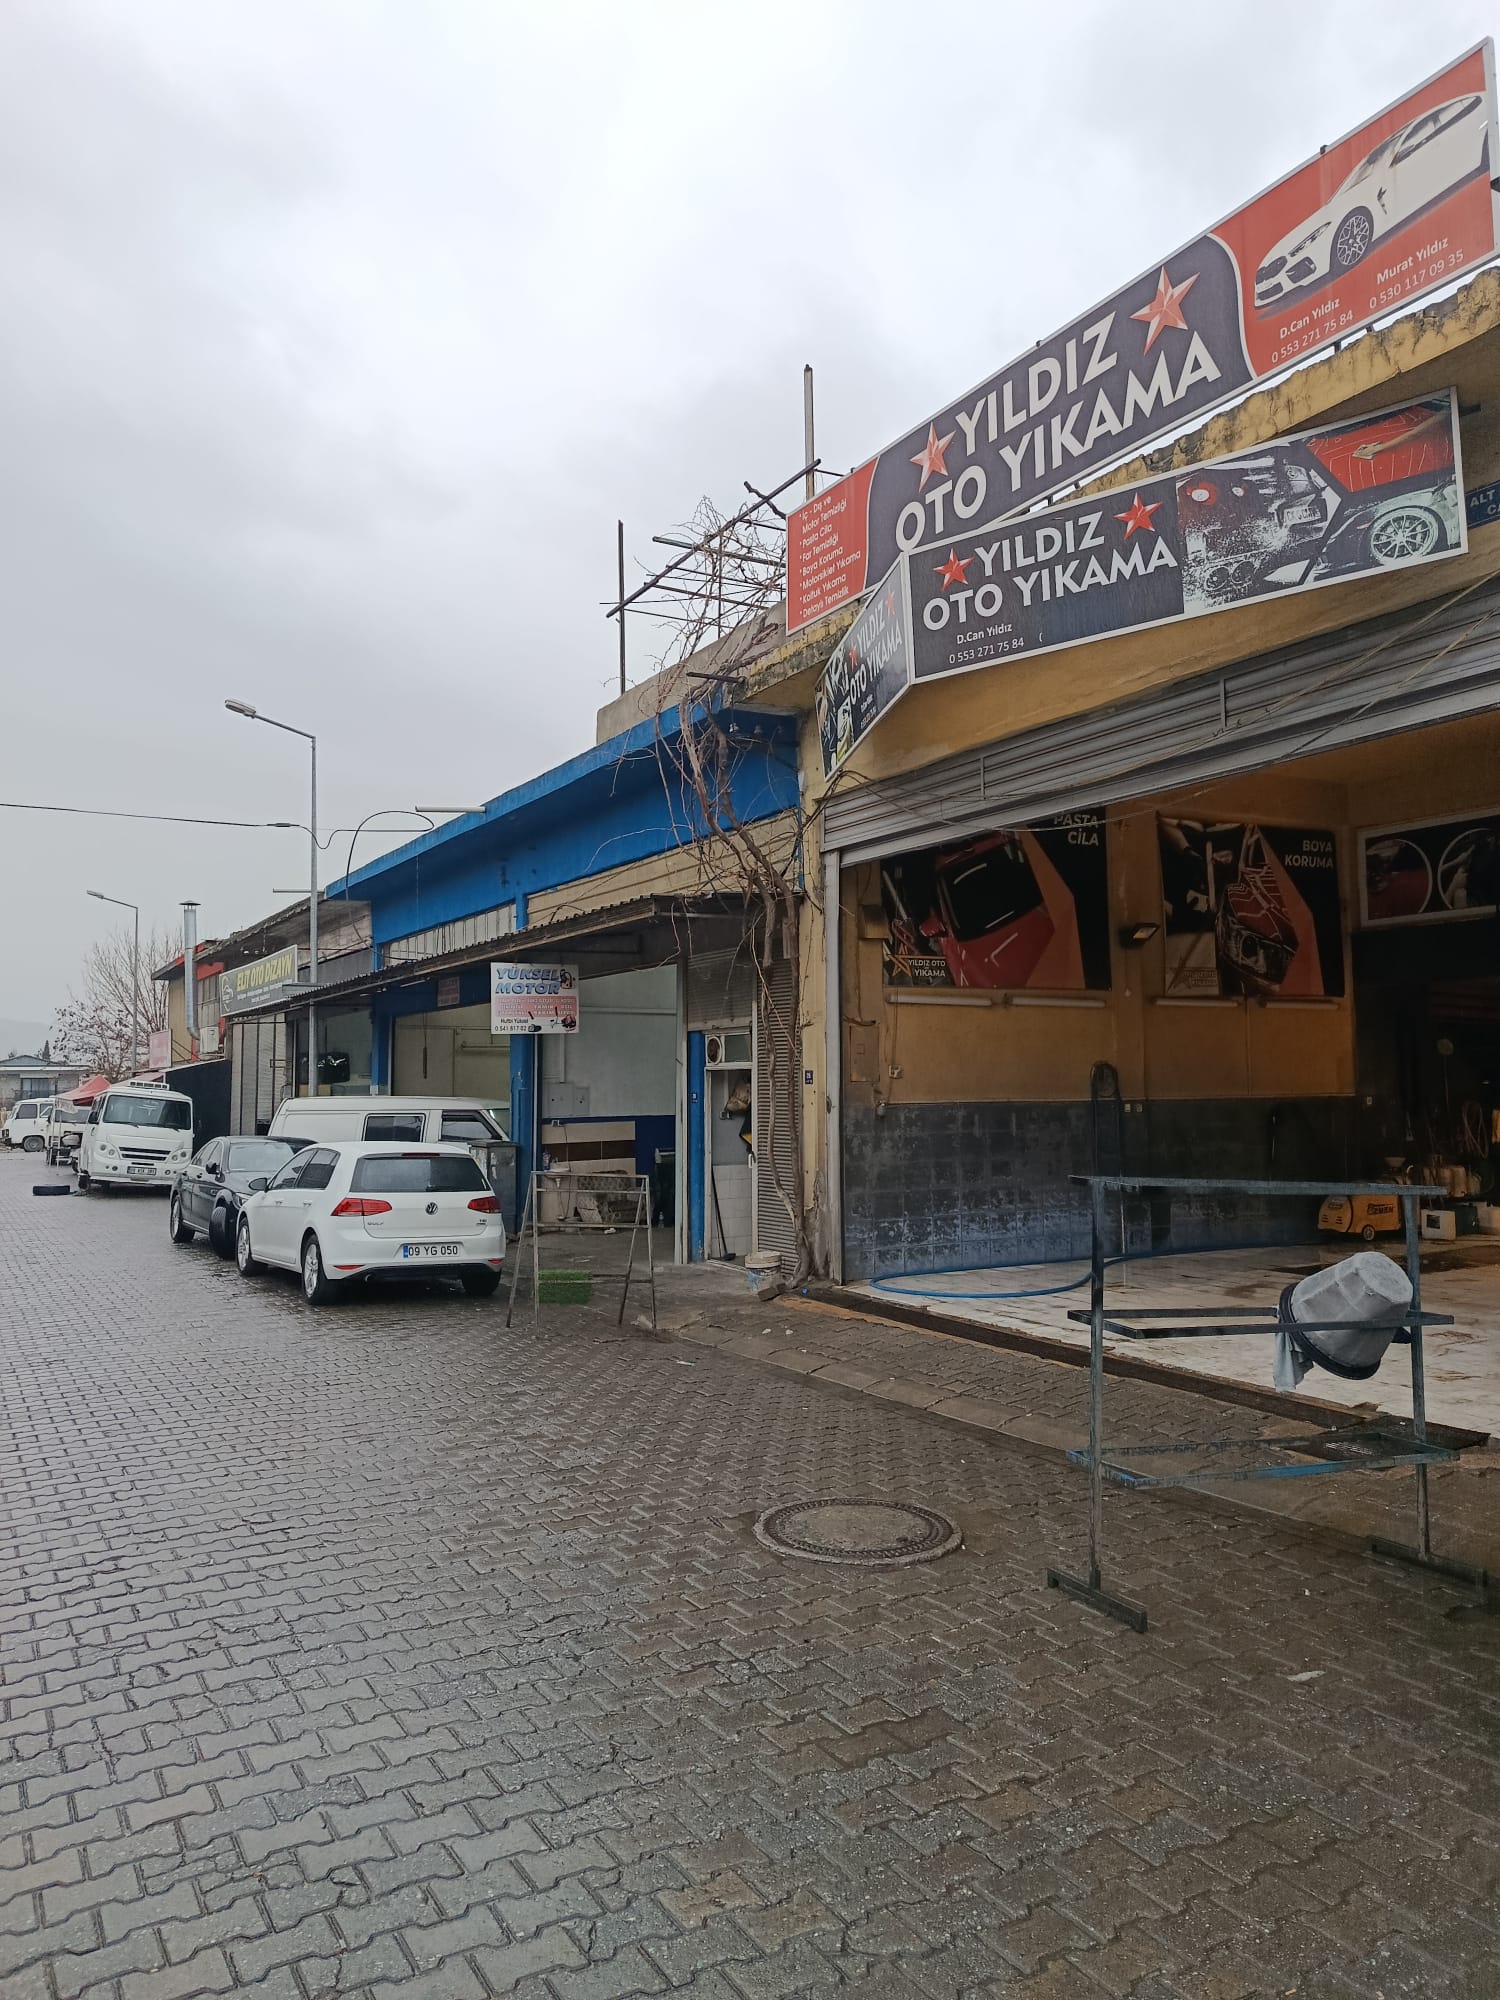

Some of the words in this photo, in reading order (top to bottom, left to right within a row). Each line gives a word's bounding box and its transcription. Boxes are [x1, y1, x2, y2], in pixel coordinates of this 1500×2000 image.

[1376, 256, 1414, 285] Murat
[1416, 237, 1449, 261] Yıldız
[1369, 296, 1377, 309] 0
[1380, 284, 1401, 304] 530
[1404, 268, 1426, 290] 117
[1429, 260, 1445, 277] 09
[1448, 248, 1465, 267] 35
[1279, 315, 1310, 339] D.Can
[1312, 298, 1340, 320] Yıldız
[1271, 351, 1279, 363] 0
[1280, 340, 1299, 359] 553
[1302, 327, 1320, 346] 271
[1323, 319, 1337, 335] 75
[1339, 310, 1354, 326] 84
[955, 310, 1118, 456] YILDIZ
[895, 465, 987, 551] OTO
[999, 330, 1223, 492] YIKAMA
[1470, 489, 1496, 508] ALT
[802, 517, 820, 535] Motor
[802, 550, 812, 562] Far
[974, 511, 1105, 577] YILDIZ
[802, 561, 818, 577] Boya
[819, 546, 843, 566] Koruma
[922, 583, 1003, 631] OTO
[1012, 535, 1178, 607] YIKAMA
[857, 599, 885, 658] YILDIZ
[956, 631, 984, 645] D.Can
[986, 623, 1013, 637] Yıldız
[850, 664, 867, 705] OTO
[866, 620, 903, 682] YIKAMA
[949, 654, 956, 664] 0
[957, 649, 975, 663] 553
[977, 644, 995, 657] 271
[997, 640, 1010, 653] 75
[1012, 637, 1025, 649] 84
[1067, 828, 1099, 847] CİLA
[1302, 839, 1333, 853] BOYA
[1284, 853, 1334, 869] KORUMA
[496, 966, 560, 981] YÜKSEL
[908, 959, 930, 967] YILDIZ
[914, 968, 946, 977] YIKAMA
[495, 981, 560, 995] MOTOR
[408, 1246, 421, 1257] 09
[423, 1245, 438, 1256] YG
[440, 1245, 458, 1256] 050
